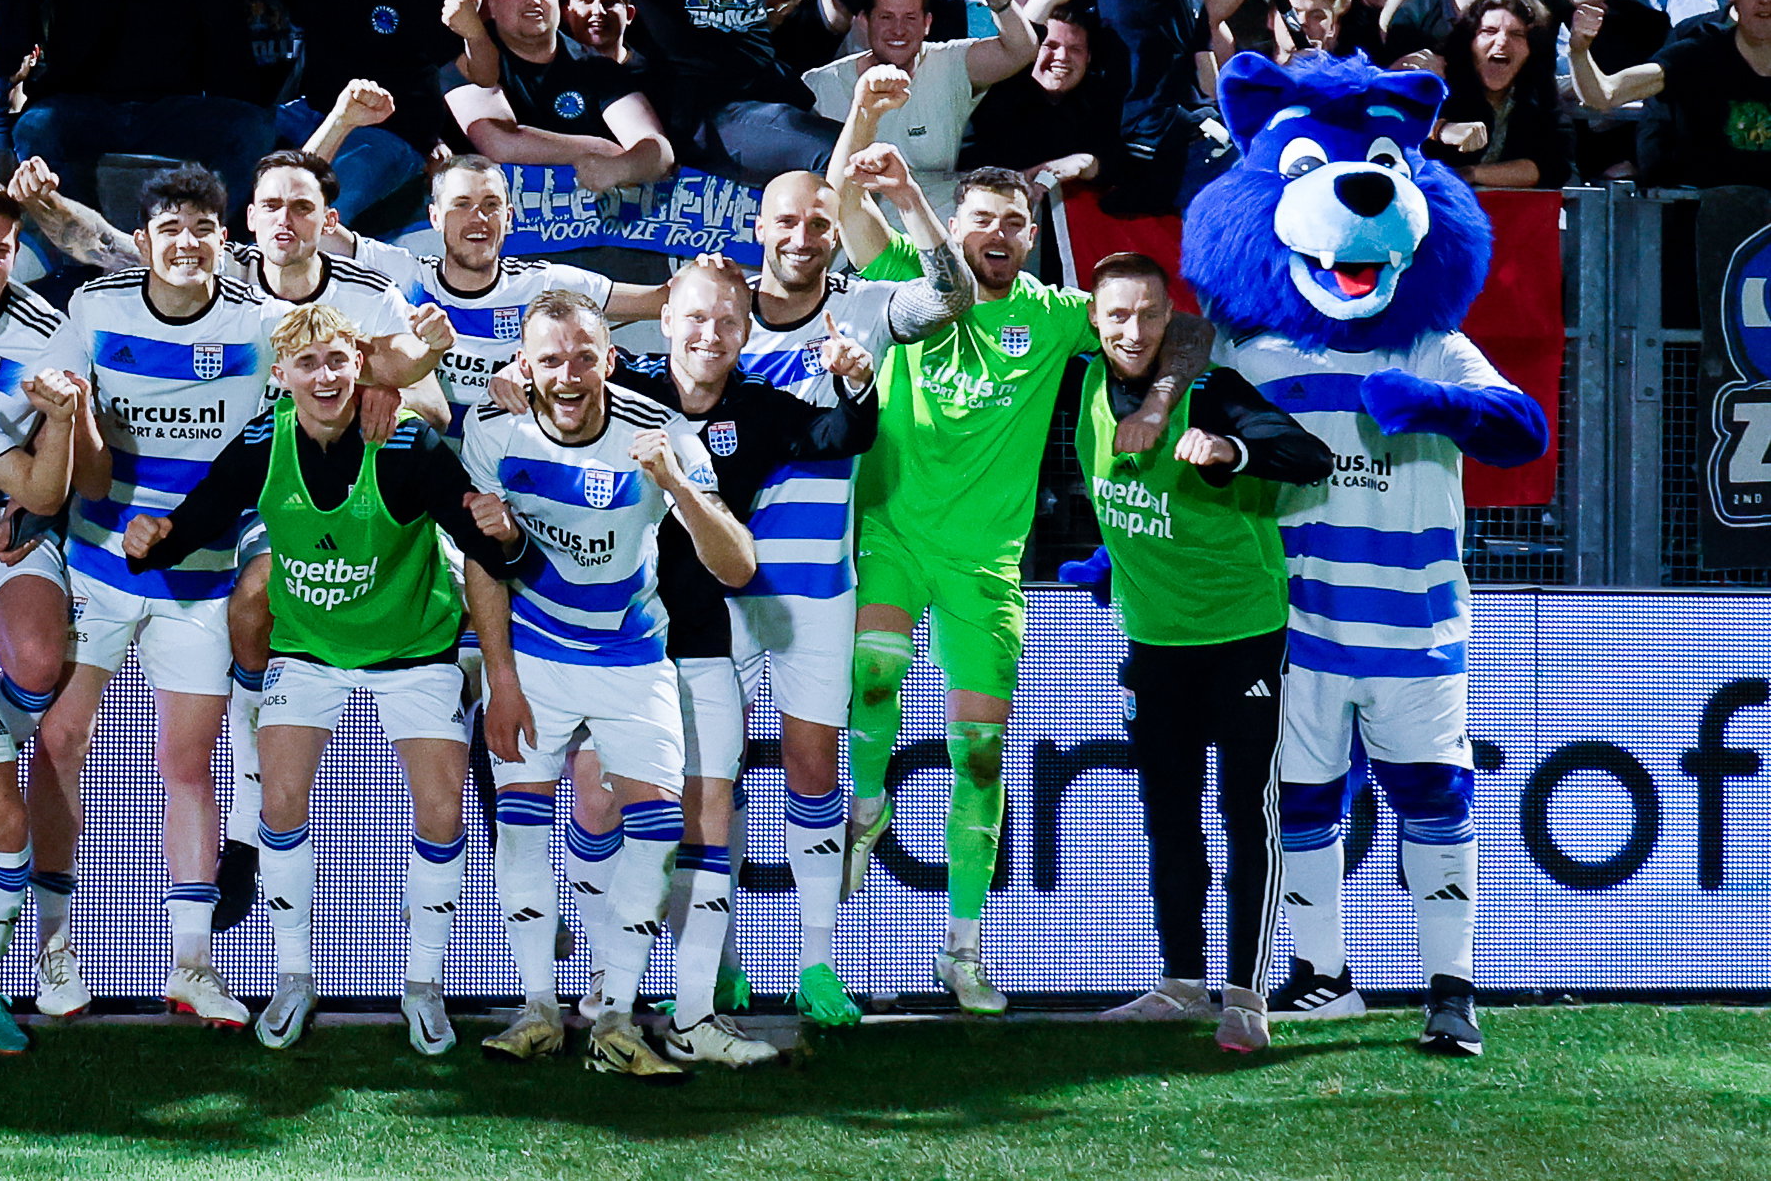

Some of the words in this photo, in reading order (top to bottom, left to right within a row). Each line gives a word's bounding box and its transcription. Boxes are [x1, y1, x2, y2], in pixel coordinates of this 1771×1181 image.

[540, 217, 601, 241] VOOR
[603, 216, 661, 241] ONZE
[662, 221, 732, 252] TROTS
[155, 427, 166, 439] &
[169, 426, 223, 440] CASINO
[1092, 476, 1169, 517] voetbal
[1343, 475, 1389, 492] CASINO
[279, 553, 378, 583] voetbal
[285, 576, 375, 610] shop.nl
